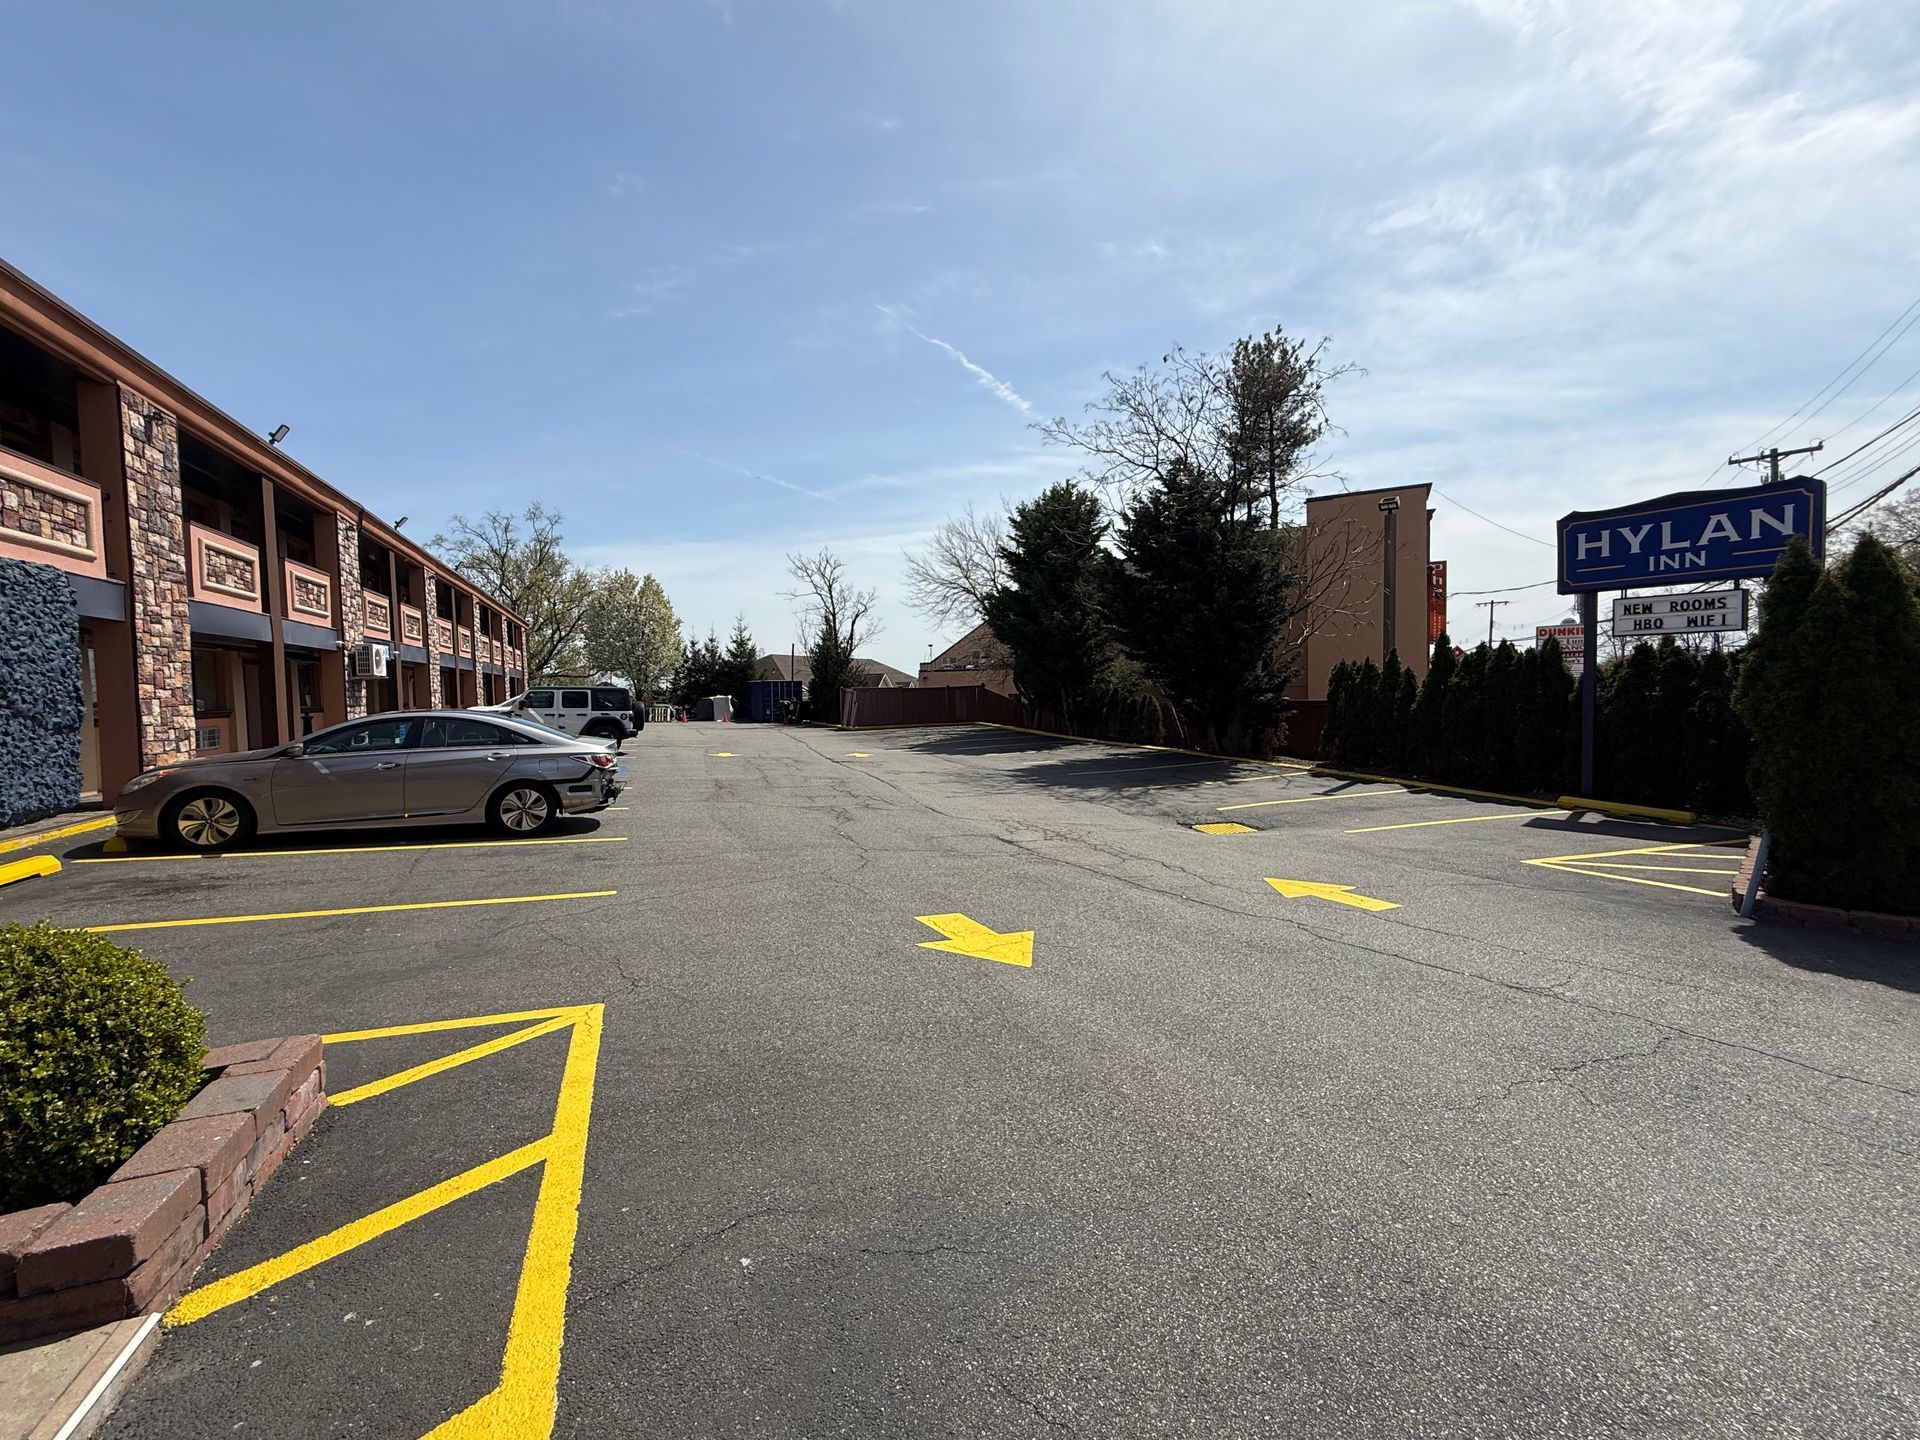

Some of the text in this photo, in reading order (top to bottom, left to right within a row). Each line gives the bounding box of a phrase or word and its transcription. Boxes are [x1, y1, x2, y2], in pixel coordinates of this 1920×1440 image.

[1576, 504, 1796, 560] HYLAN
[1649, 551, 1706, 572] INN
[1623, 598, 1727, 616] NEW ROOMS
[1634, 618, 1664, 630] HBO
